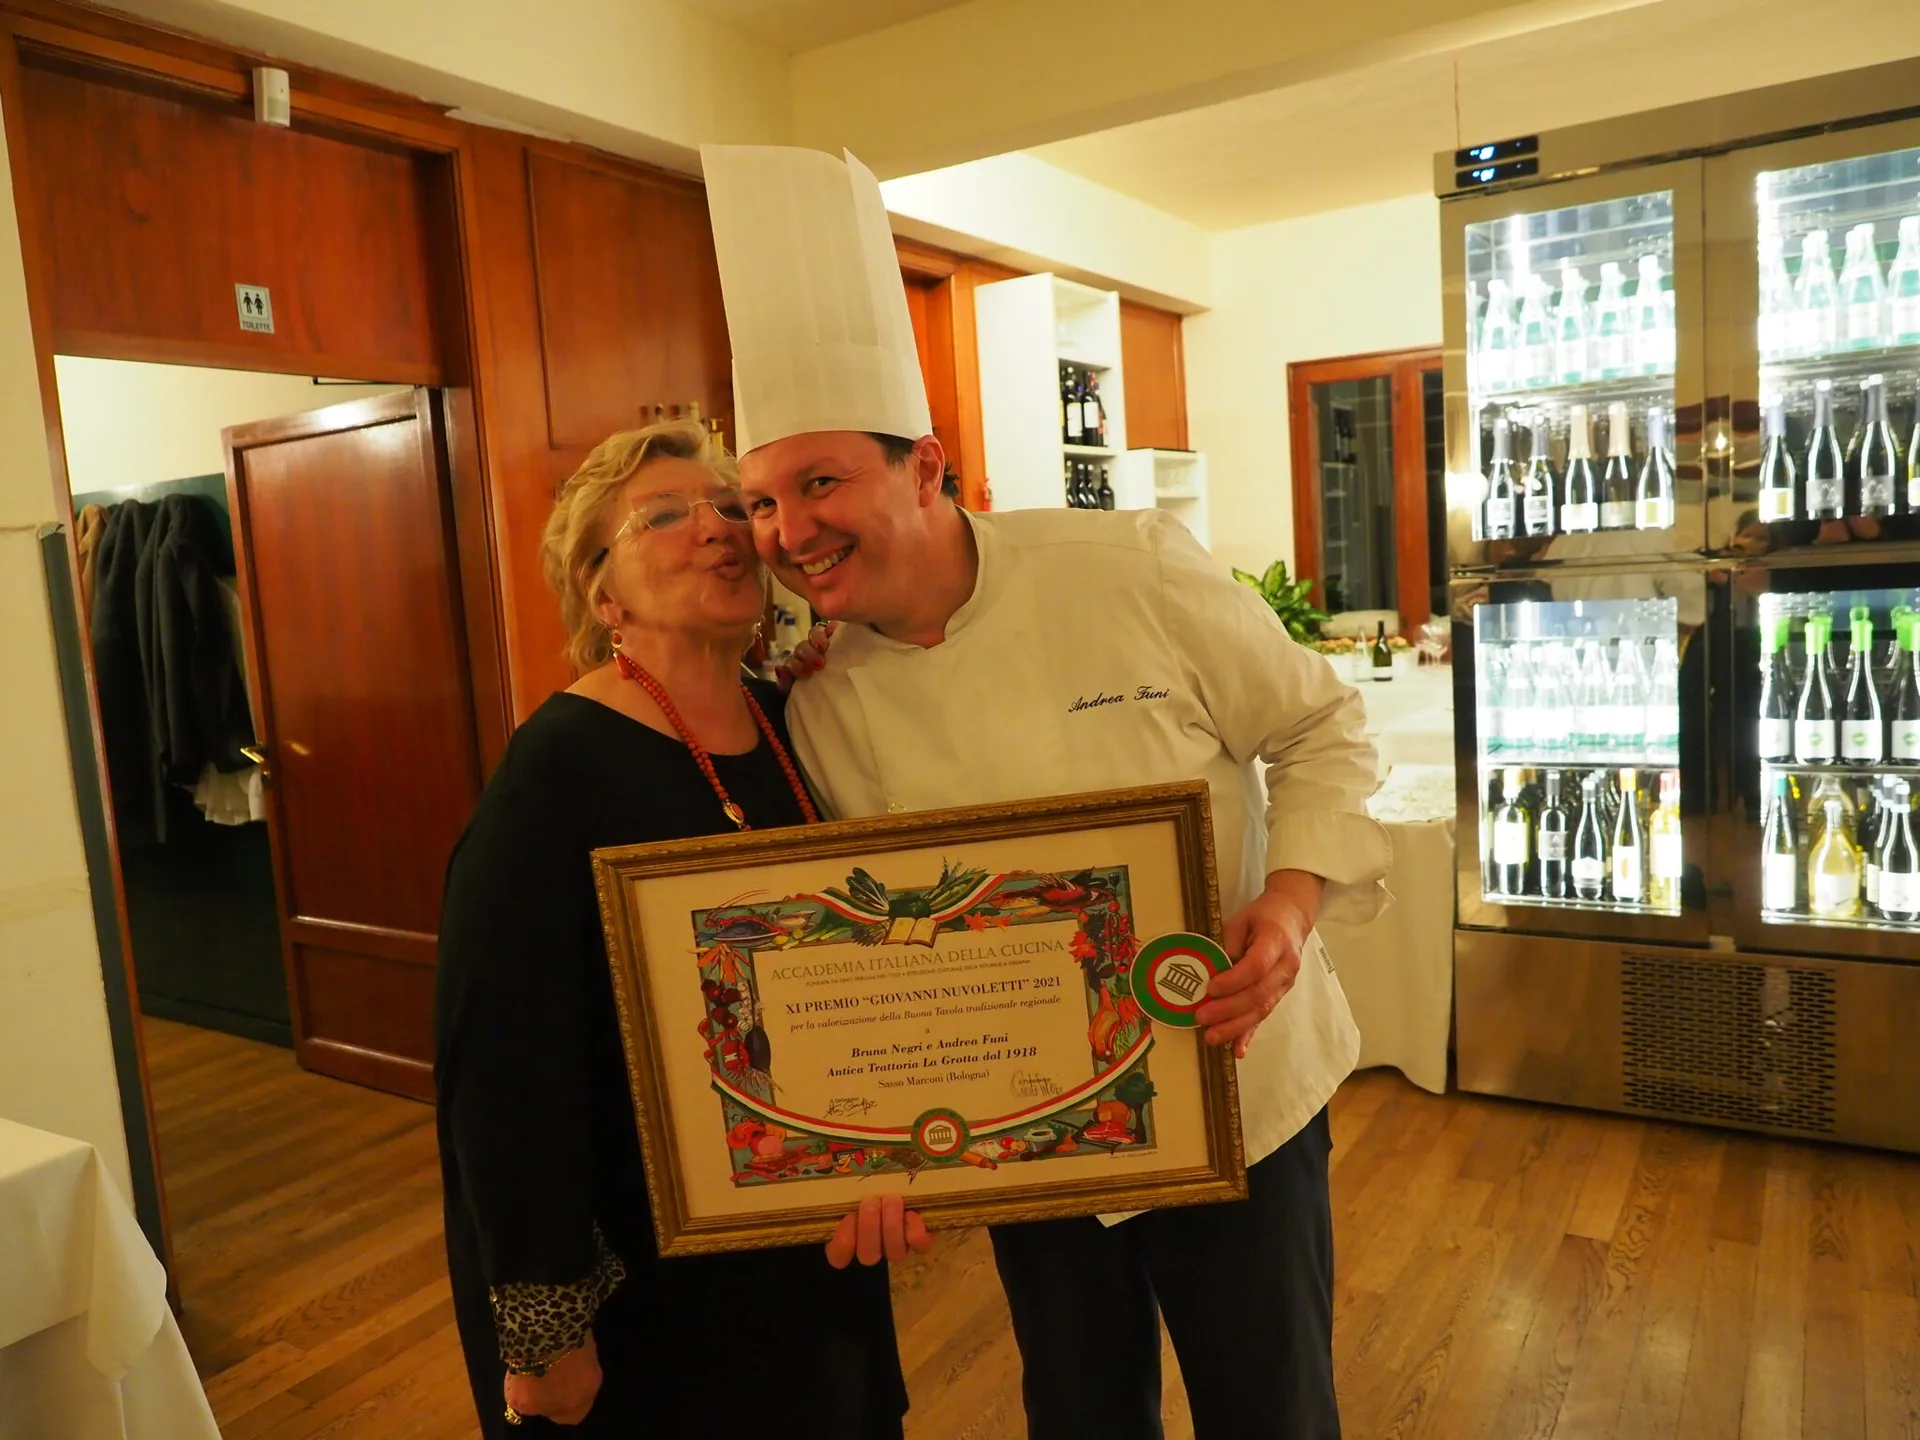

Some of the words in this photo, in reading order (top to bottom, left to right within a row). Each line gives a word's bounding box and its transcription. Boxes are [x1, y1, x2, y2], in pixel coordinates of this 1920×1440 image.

[1068, 692, 1124, 713] Andrea
[1133, 685, 1170, 701] Funi
[770, 960, 865, 981] ACCADEMIA
[869, 952, 944, 971] ITALIANA
[948, 947, 996, 963] DELLA
[1000, 940, 1064, 957] CUCINA
[785, 1003, 802, 1015] XI
[804, 996, 860, 1013] PREMIO
[1033, 976, 1060, 989] 2021
[790, 1023, 804, 1032] per
[806, 1020, 815, 1030] la
[817, 1016, 877, 1029] valorizzazione
[879, 1011, 901, 1022] della
[904, 1009, 932, 1019] Buona
[935, 1005, 963, 1016] Tavola
[966, 1000, 1018, 1013] tradizionale
[1020, 995, 1061, 1008] regionale
[851, 1047, 887, 1058] Bruna
[891, 1042, 923, 1055] Negri
[936, 1037, 978, 1049] Andrea
[982, 1033, 1009, 1045] Funi
[827, 1066, 864, 1078] Antica
[868, 1060, 919, 1073] Trattoria
[923, 1058, 937, 1068] La
[941, 1054, 979, 1066] Grotta
[982, 1050, 1001, 1061] dal
[1005, 1047, 1037, 1059] 1918
[877, 1079, 904, 1088] Sasso
[906, 1074, 944, 1086] Marconi
[946, 1068, 990, 1084] (Bologna)
